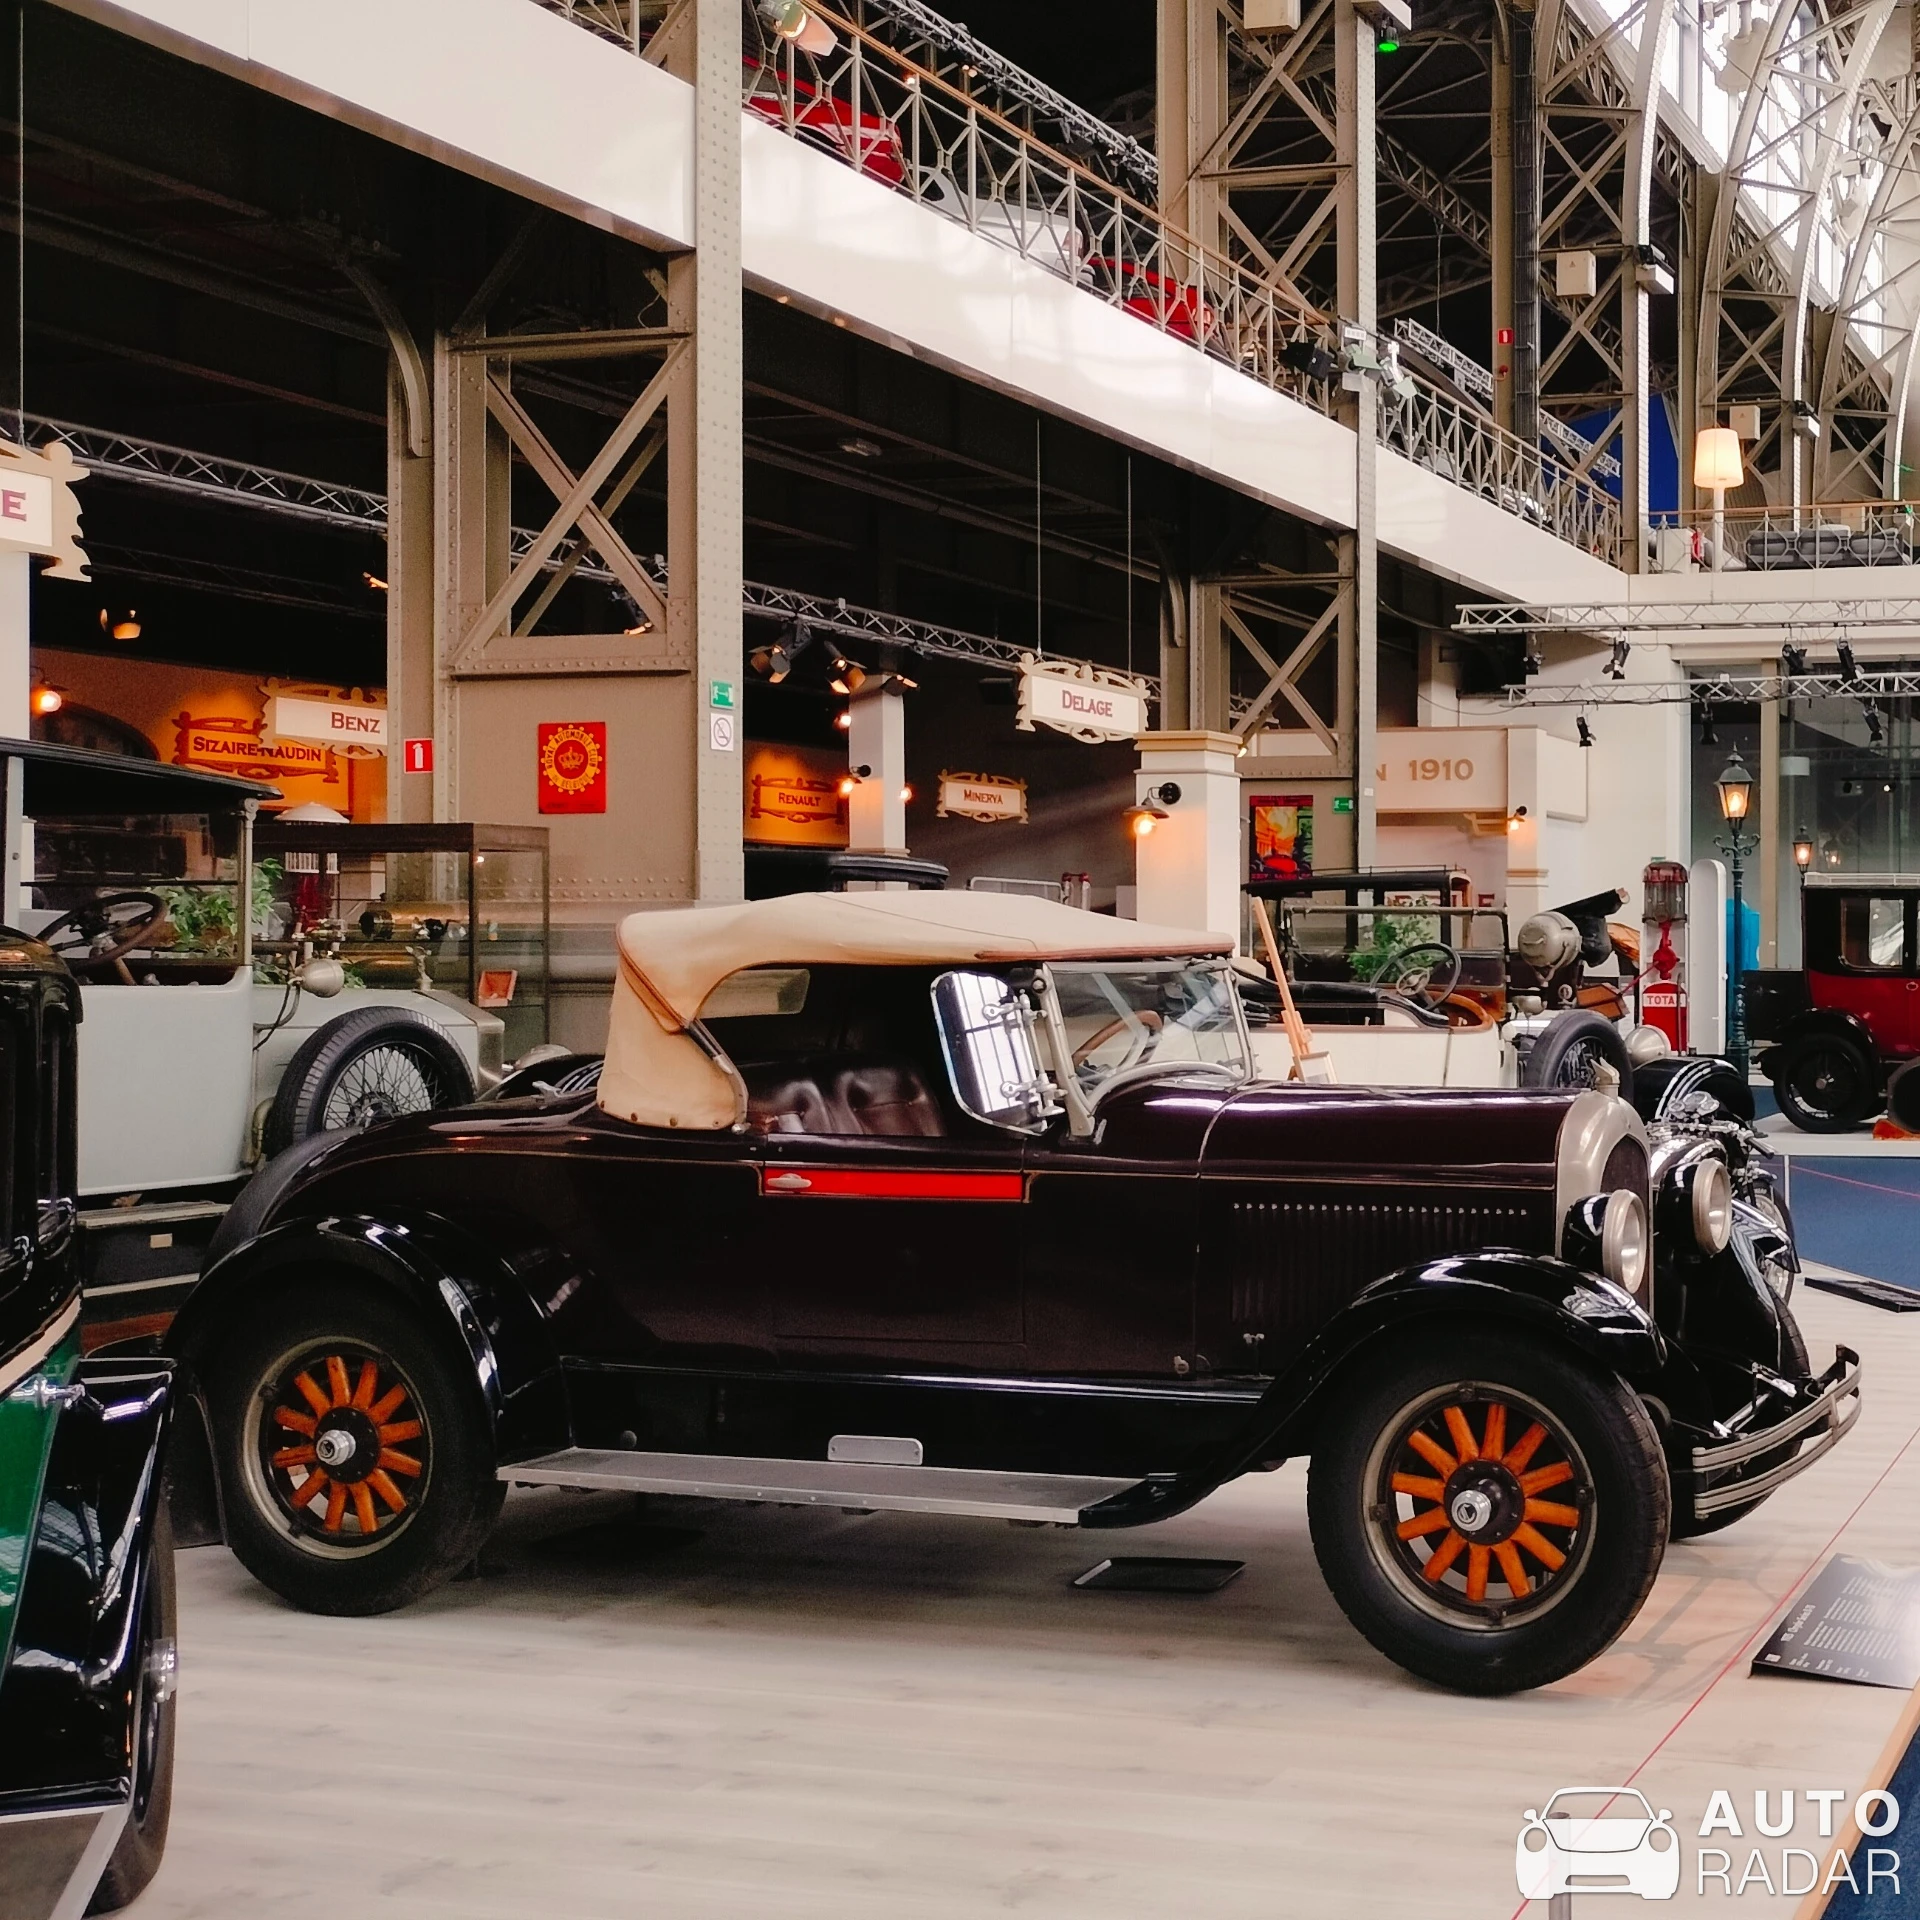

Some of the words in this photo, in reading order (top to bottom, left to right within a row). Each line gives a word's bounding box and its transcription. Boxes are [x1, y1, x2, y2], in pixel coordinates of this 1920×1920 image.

[1062, 690, 1113, 717] DELAGE
[331, 711, 380, 734] BENZ
[193, 735, 321, 762] SIZAIRE-NAUDIN
[1409, 758, 1474, 781] 1910
[778, 792, 821, 807] RENAULT
[963, 789, 1003, 805] MINERVA
[1647, 995, 1681, 1005] TOTA
